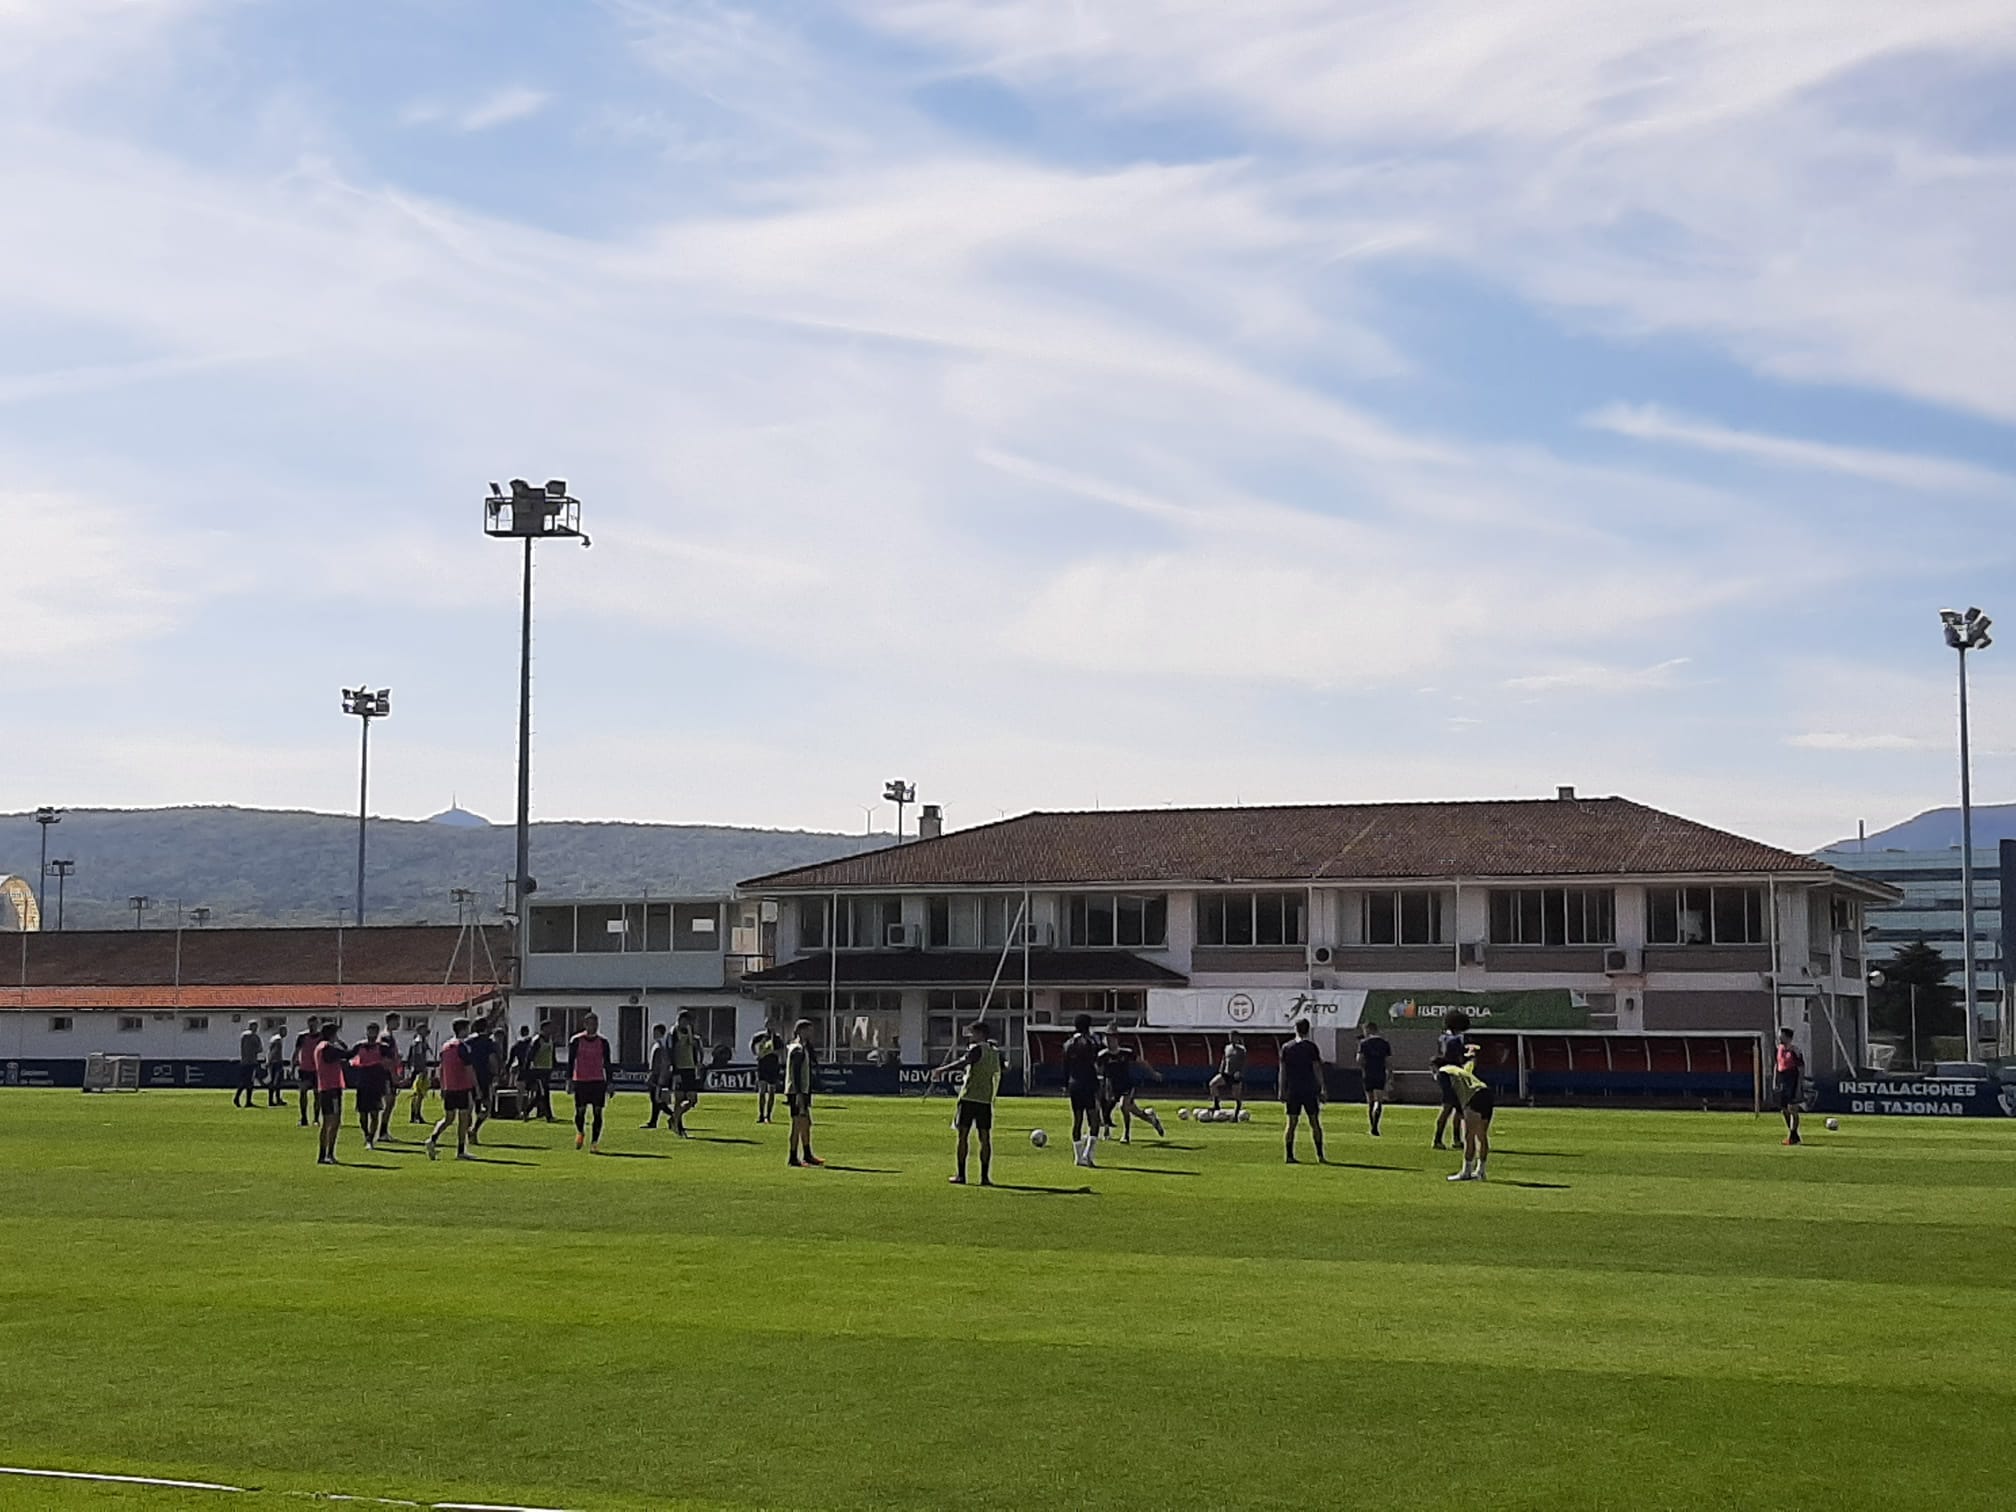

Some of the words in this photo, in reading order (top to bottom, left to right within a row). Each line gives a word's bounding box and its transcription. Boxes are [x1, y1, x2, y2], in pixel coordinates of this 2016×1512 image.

[1838, 1081, 1977, 1097] INSTALACIONES
[1851, 1101, 1875, 1112] DE
[1881, 1101, 1964, 1114] TAJONAR
